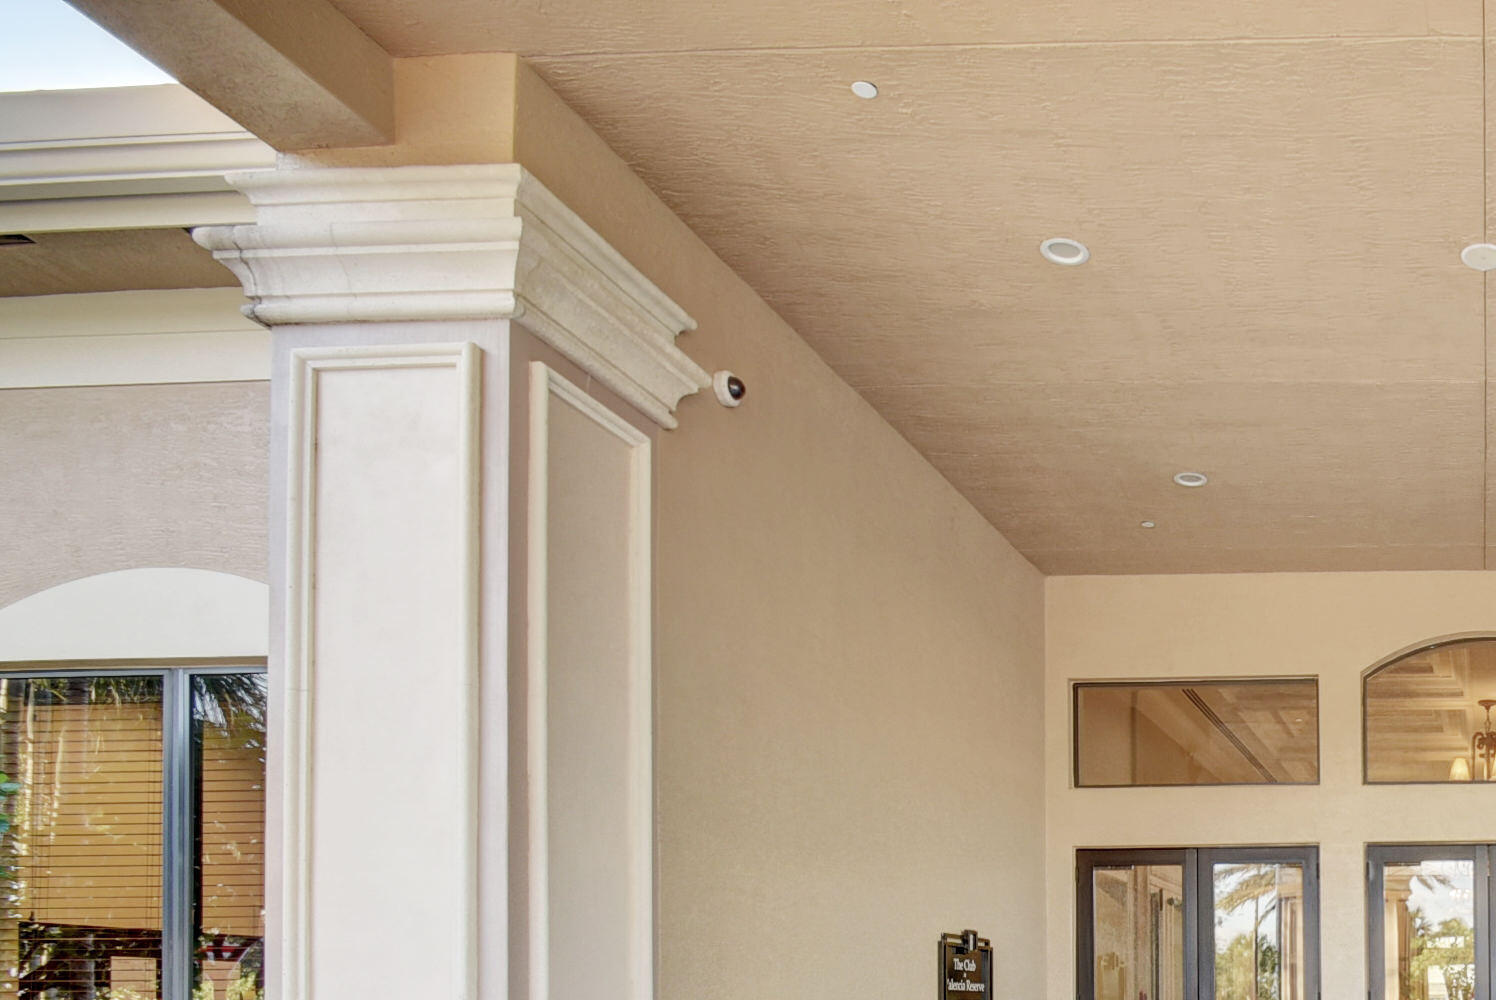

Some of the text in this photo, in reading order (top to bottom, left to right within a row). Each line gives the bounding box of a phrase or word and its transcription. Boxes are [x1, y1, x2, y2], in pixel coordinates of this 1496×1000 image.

[953, 957, 977, 972] The Club
[966, 979, 985, 992] Reserve
